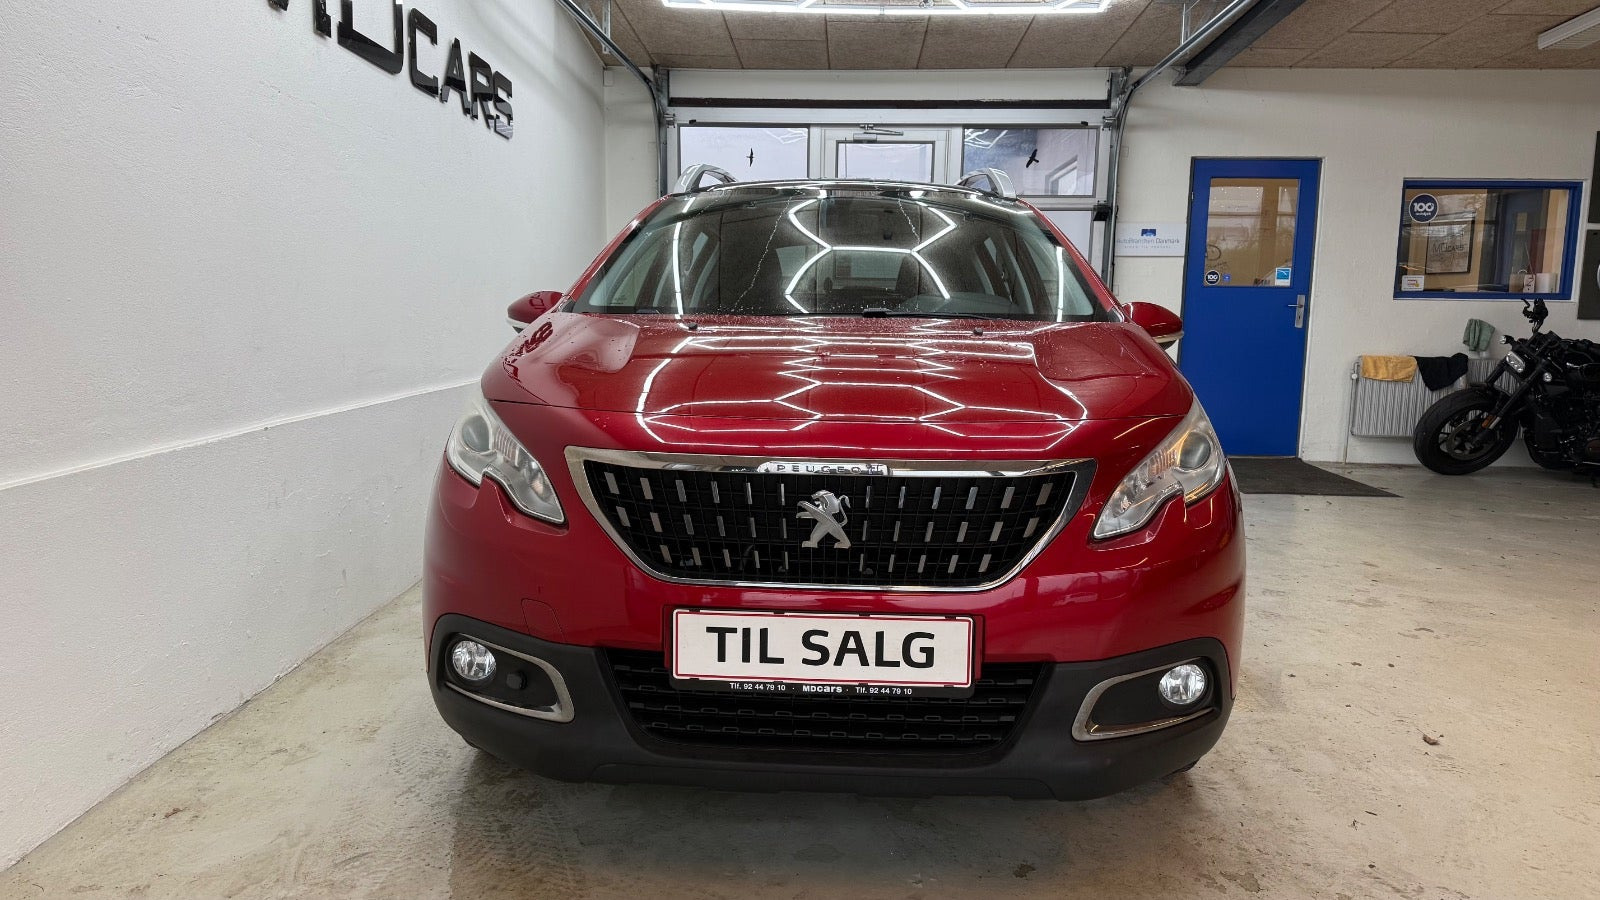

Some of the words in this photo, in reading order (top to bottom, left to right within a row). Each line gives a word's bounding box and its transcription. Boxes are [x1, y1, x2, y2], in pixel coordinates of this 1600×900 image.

[706, 626, 784, 664] TIL
[801, 629, 935, 668] SALG
[754, 683, 764, 691] 44
